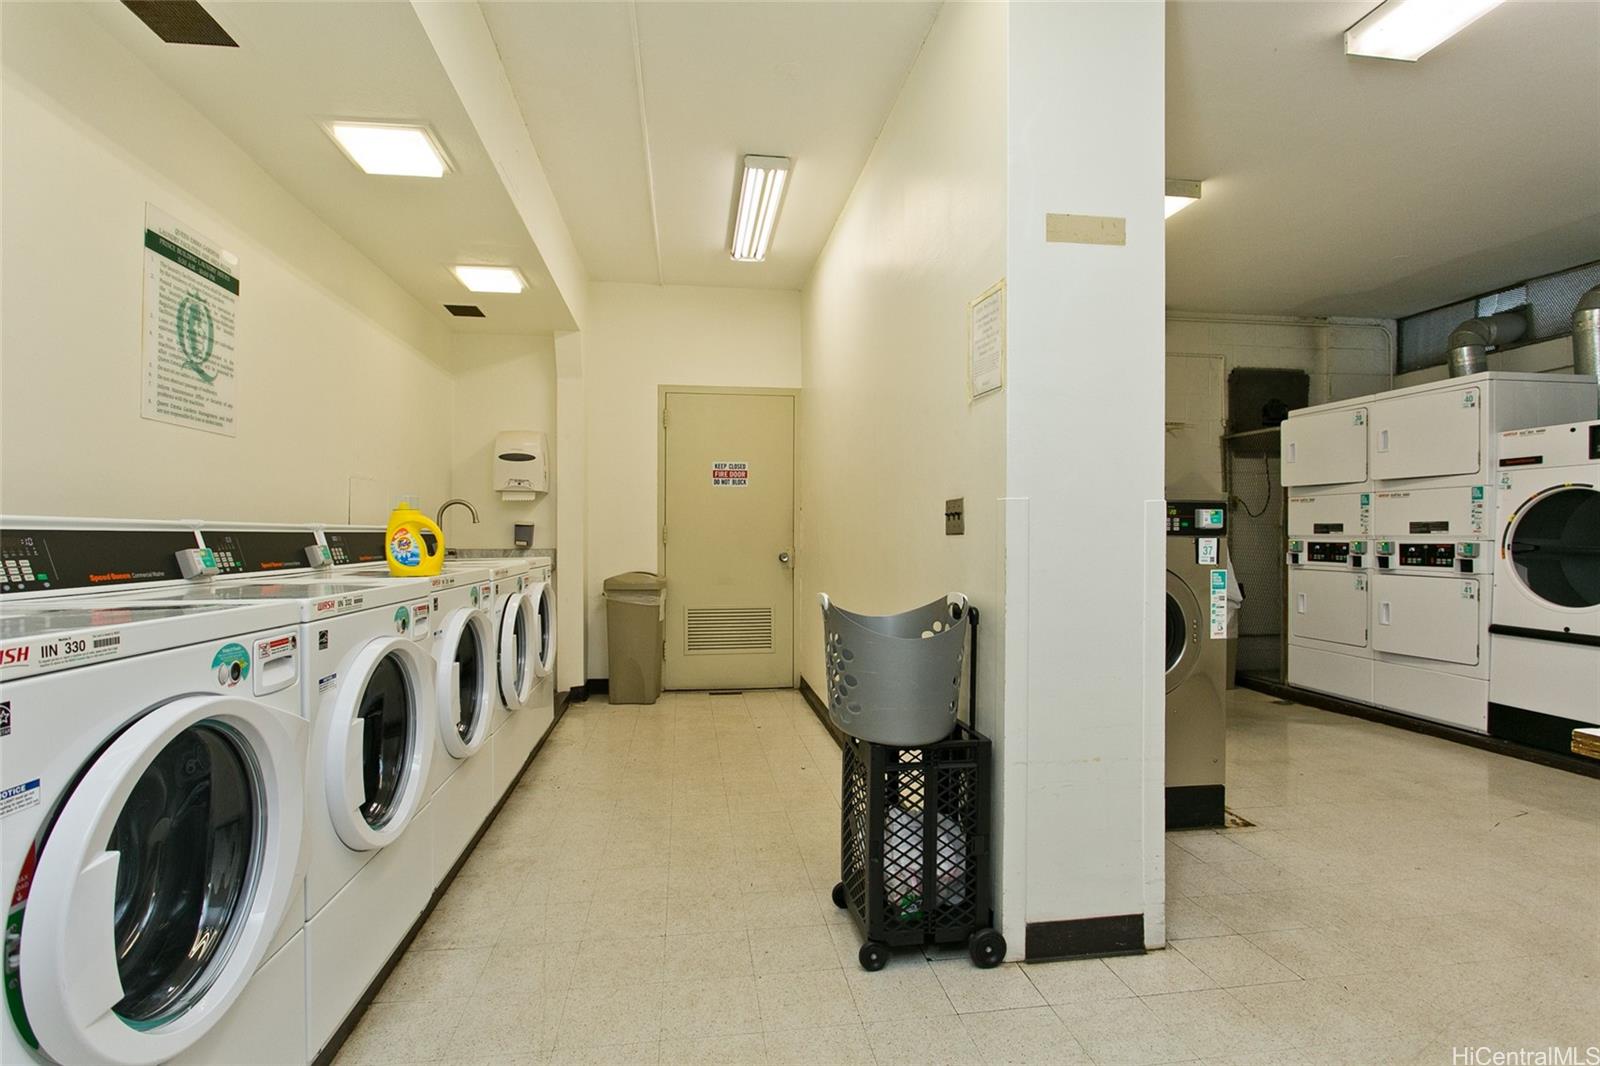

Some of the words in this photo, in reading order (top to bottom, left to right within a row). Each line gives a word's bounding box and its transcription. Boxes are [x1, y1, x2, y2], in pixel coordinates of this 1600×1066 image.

[1203, 546, 1212, 555] 37
[65, 640, 86, 654] 330
[0, 784, 26, 799] OTICE
